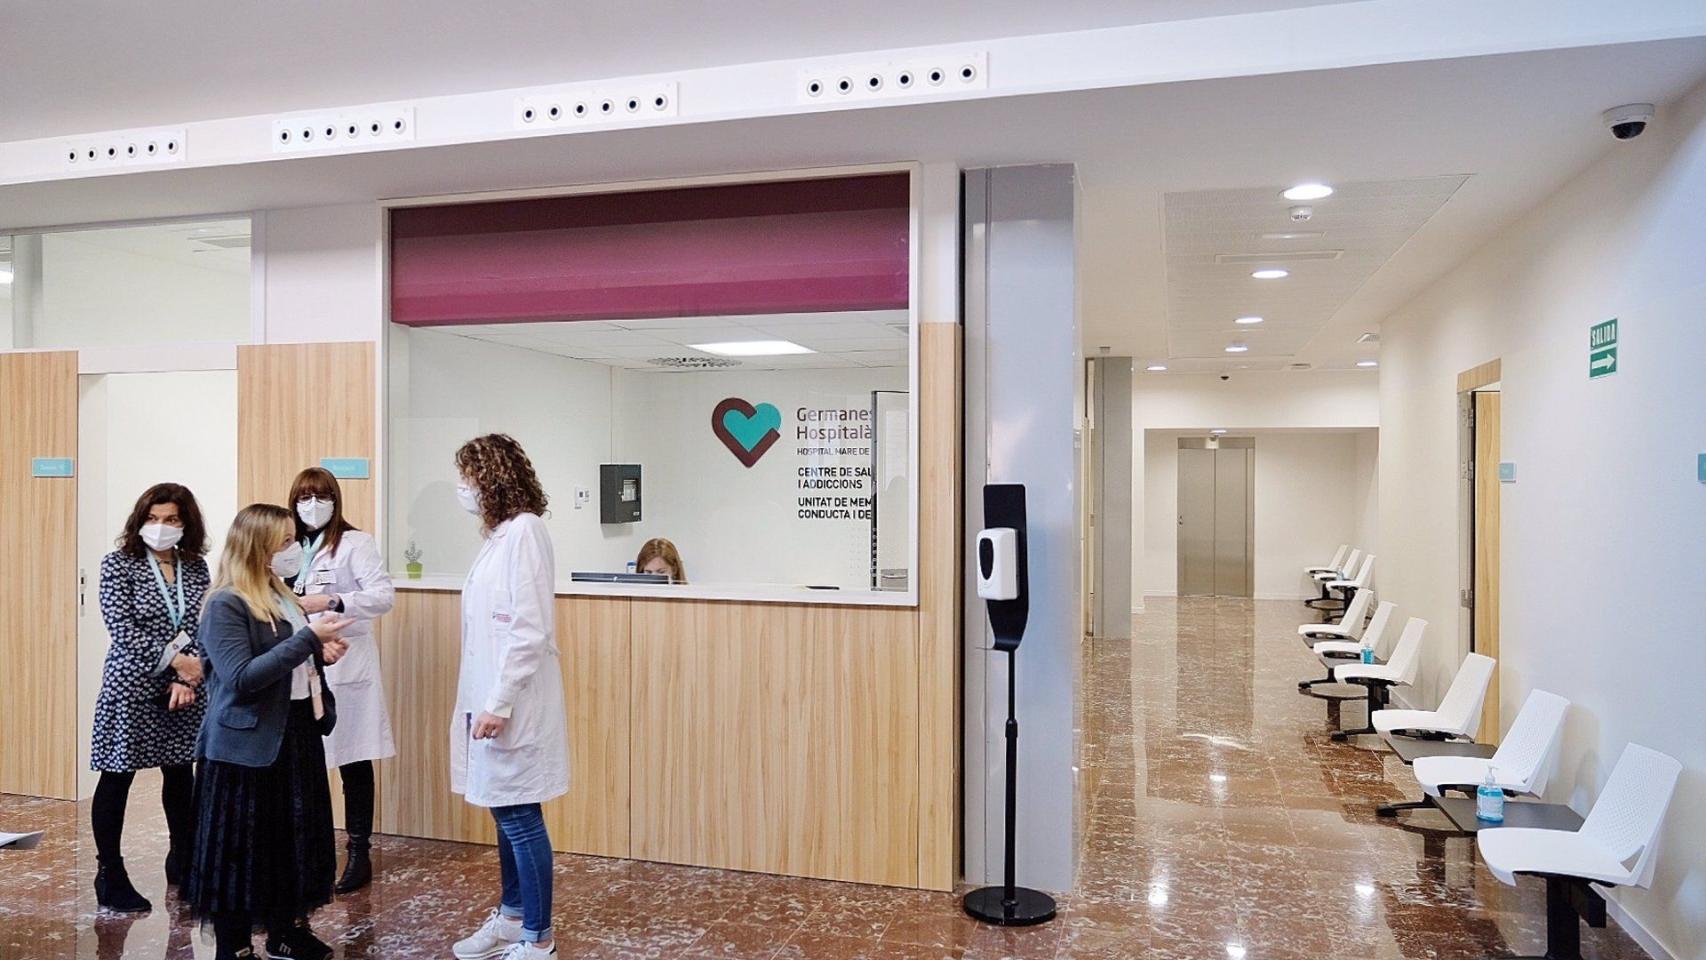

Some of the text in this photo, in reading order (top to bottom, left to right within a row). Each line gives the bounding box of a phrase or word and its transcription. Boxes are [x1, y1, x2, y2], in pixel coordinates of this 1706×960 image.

[1592, 323, 1615, 347] SALIDA
[798, 467, 837, 477] CENTRE
[839, 467, 853, 477] DE
[803, 479, 863, 489] ADDICCIONS
[798, 497, 832, 507] UNITAT
[834, 497, 848, 507] DE
[798, 509, 850, 520] CONDUCTA
